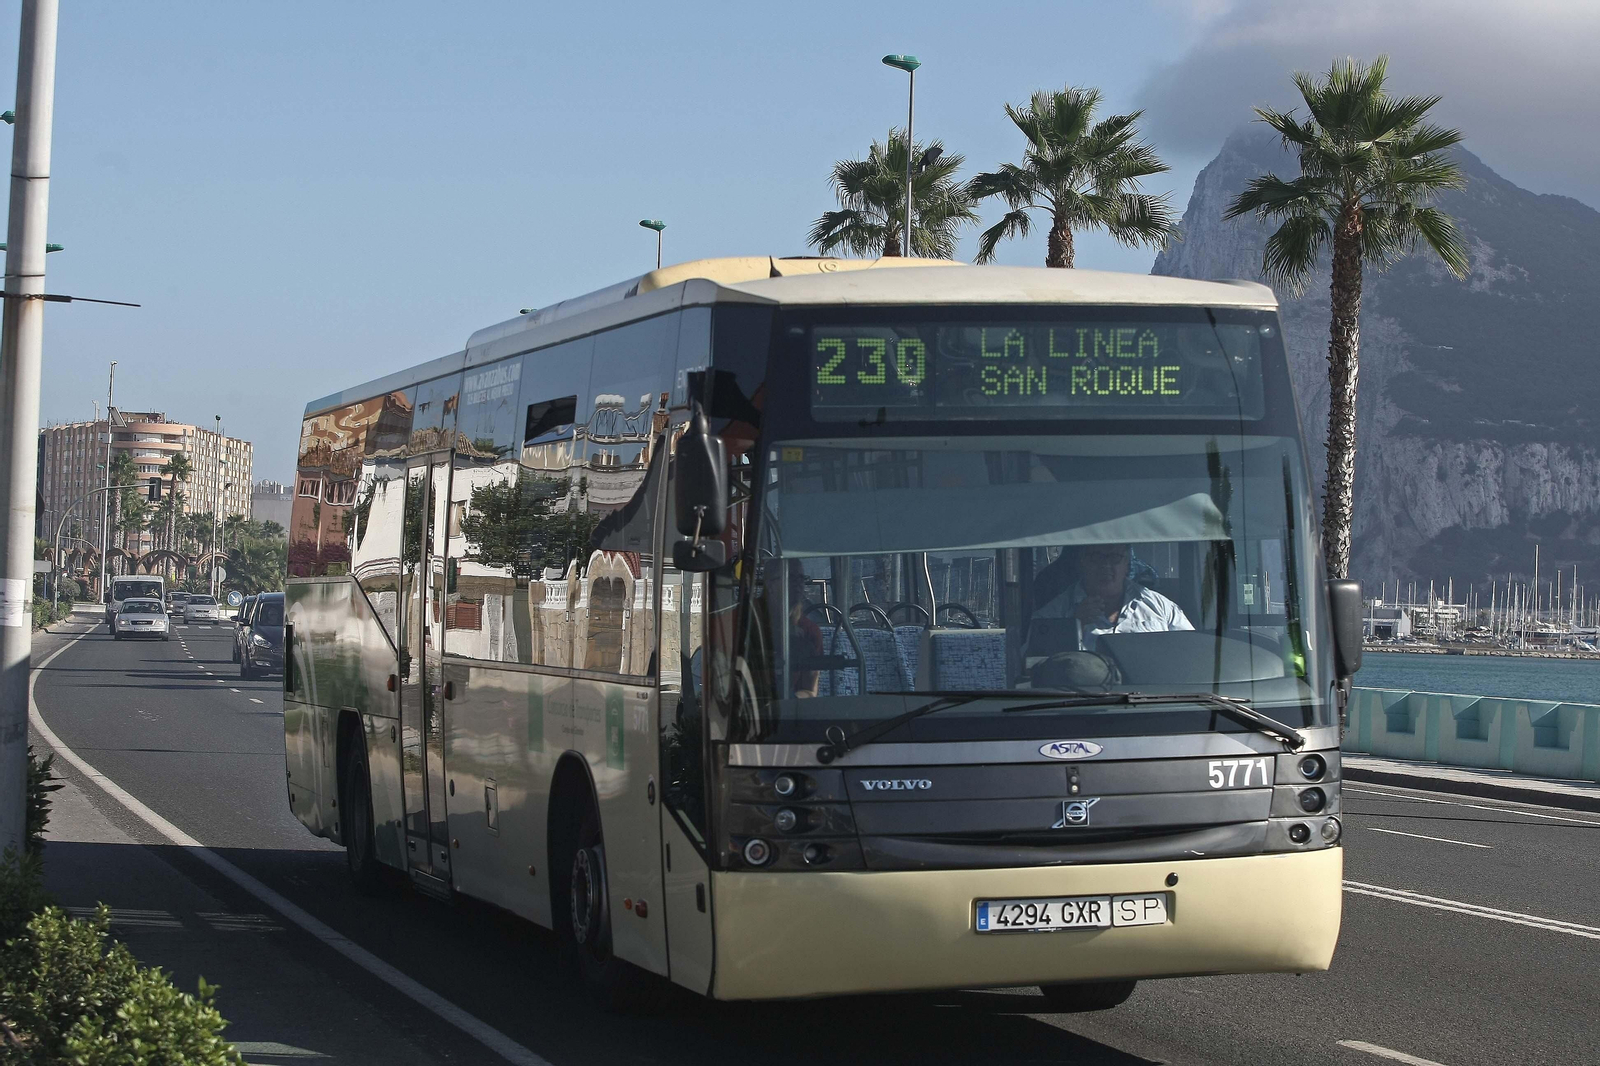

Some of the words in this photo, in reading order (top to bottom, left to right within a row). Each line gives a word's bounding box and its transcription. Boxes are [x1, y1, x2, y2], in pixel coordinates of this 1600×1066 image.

[981, 328, 1024, 358] LA
[1049, 328, 1159, 358] LINEA
[816, 338, 926, 385] 230
[981, 365, 1047, 396] SAN
[1071, 365, 1181, 396] ROQUE
[1049, 742, 1093, 755] ASTRAL
[860, 779, 932, 791] VOLVO
[1208, 758, 1268, 789] 5771
[980, 917, 987, 926] E
[996, 903, 1052, 927] 4294
[1061, 900, 1102, 924] GXR
